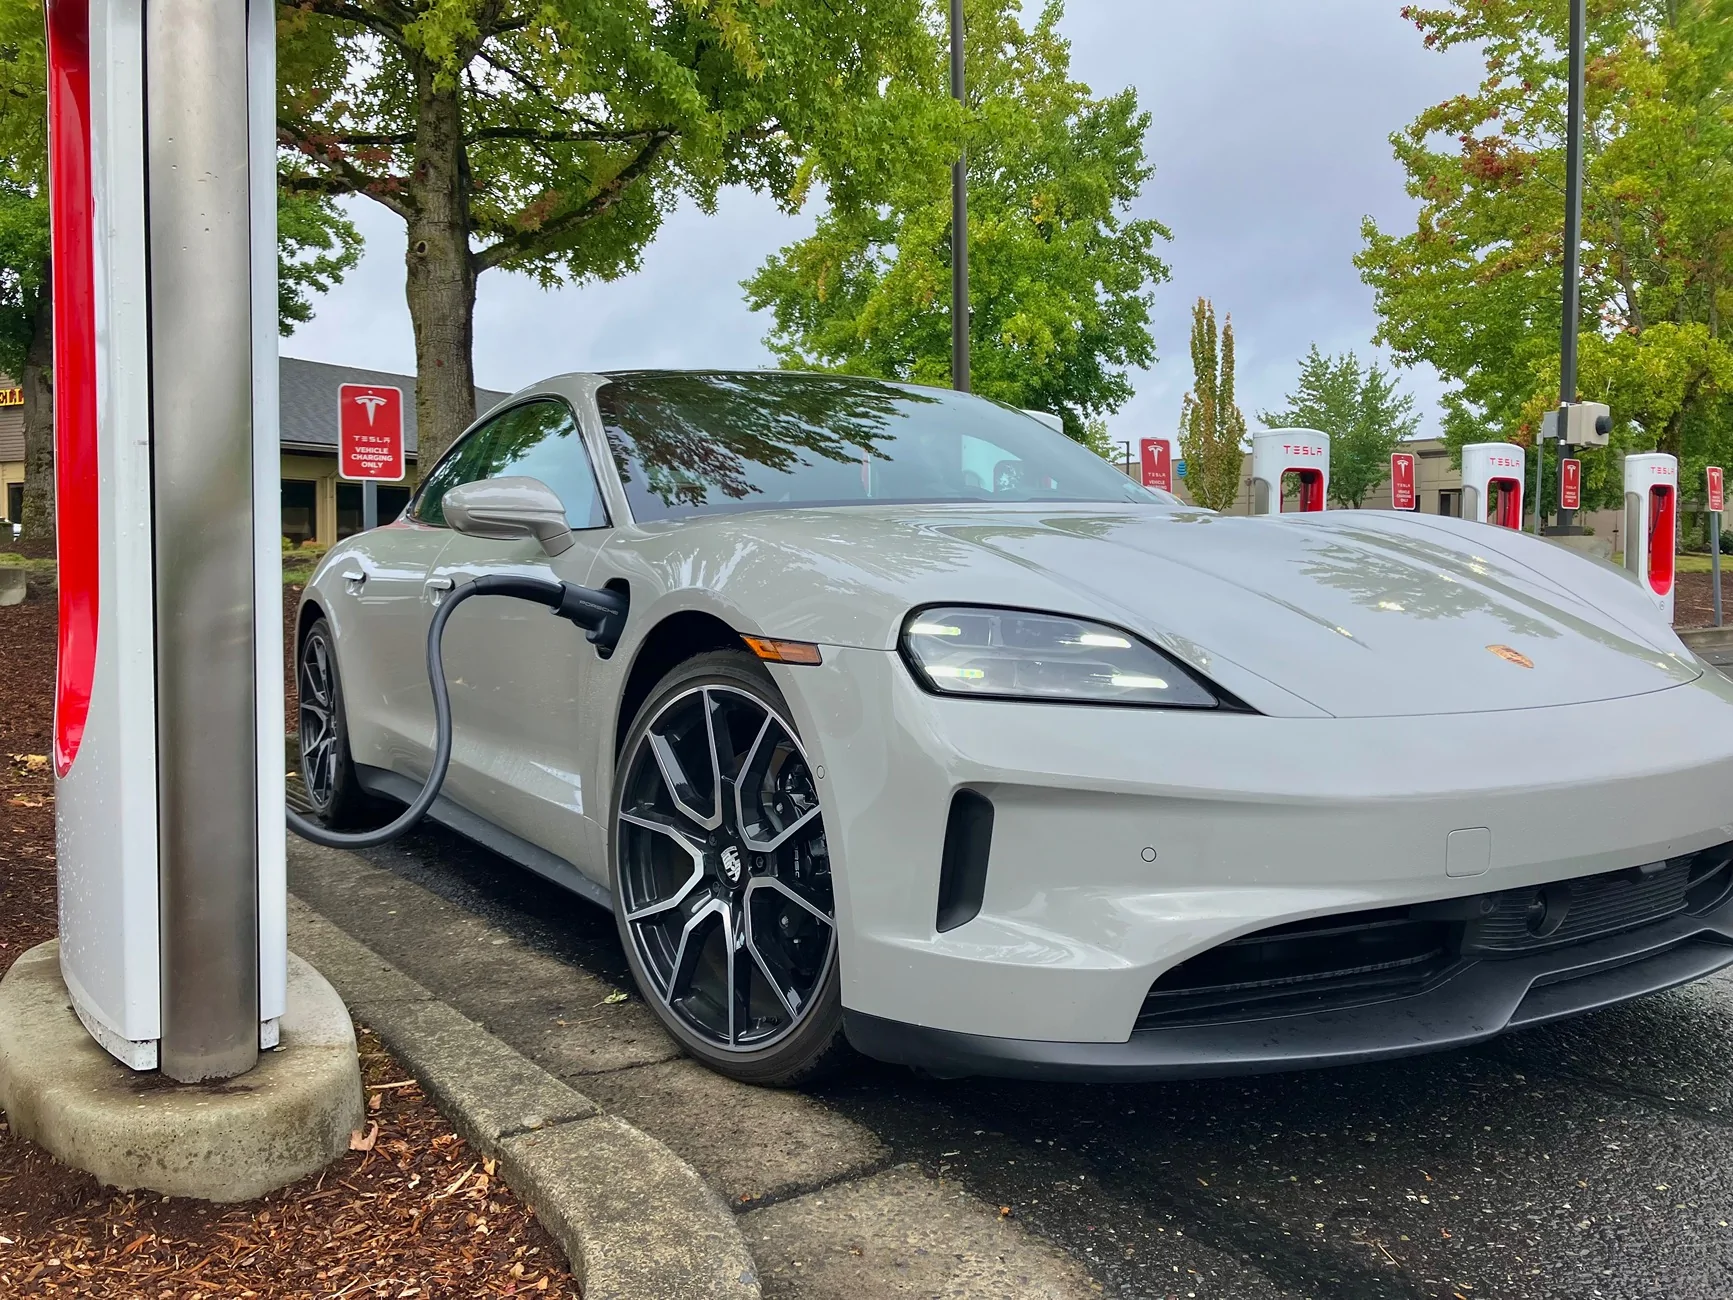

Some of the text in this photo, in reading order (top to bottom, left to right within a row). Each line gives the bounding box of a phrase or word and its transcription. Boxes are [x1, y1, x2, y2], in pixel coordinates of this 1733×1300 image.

[353, 435, 391, 443] TESLA
[354, 446, 389, 454] VEHICLE
[1283, 445, 1322, 456] TESLA
[351, 453, 393, 462] CHARGING
[1489, 457, 1520, 467] TESLA
[1650, 466, 1675, 475] TESLA
